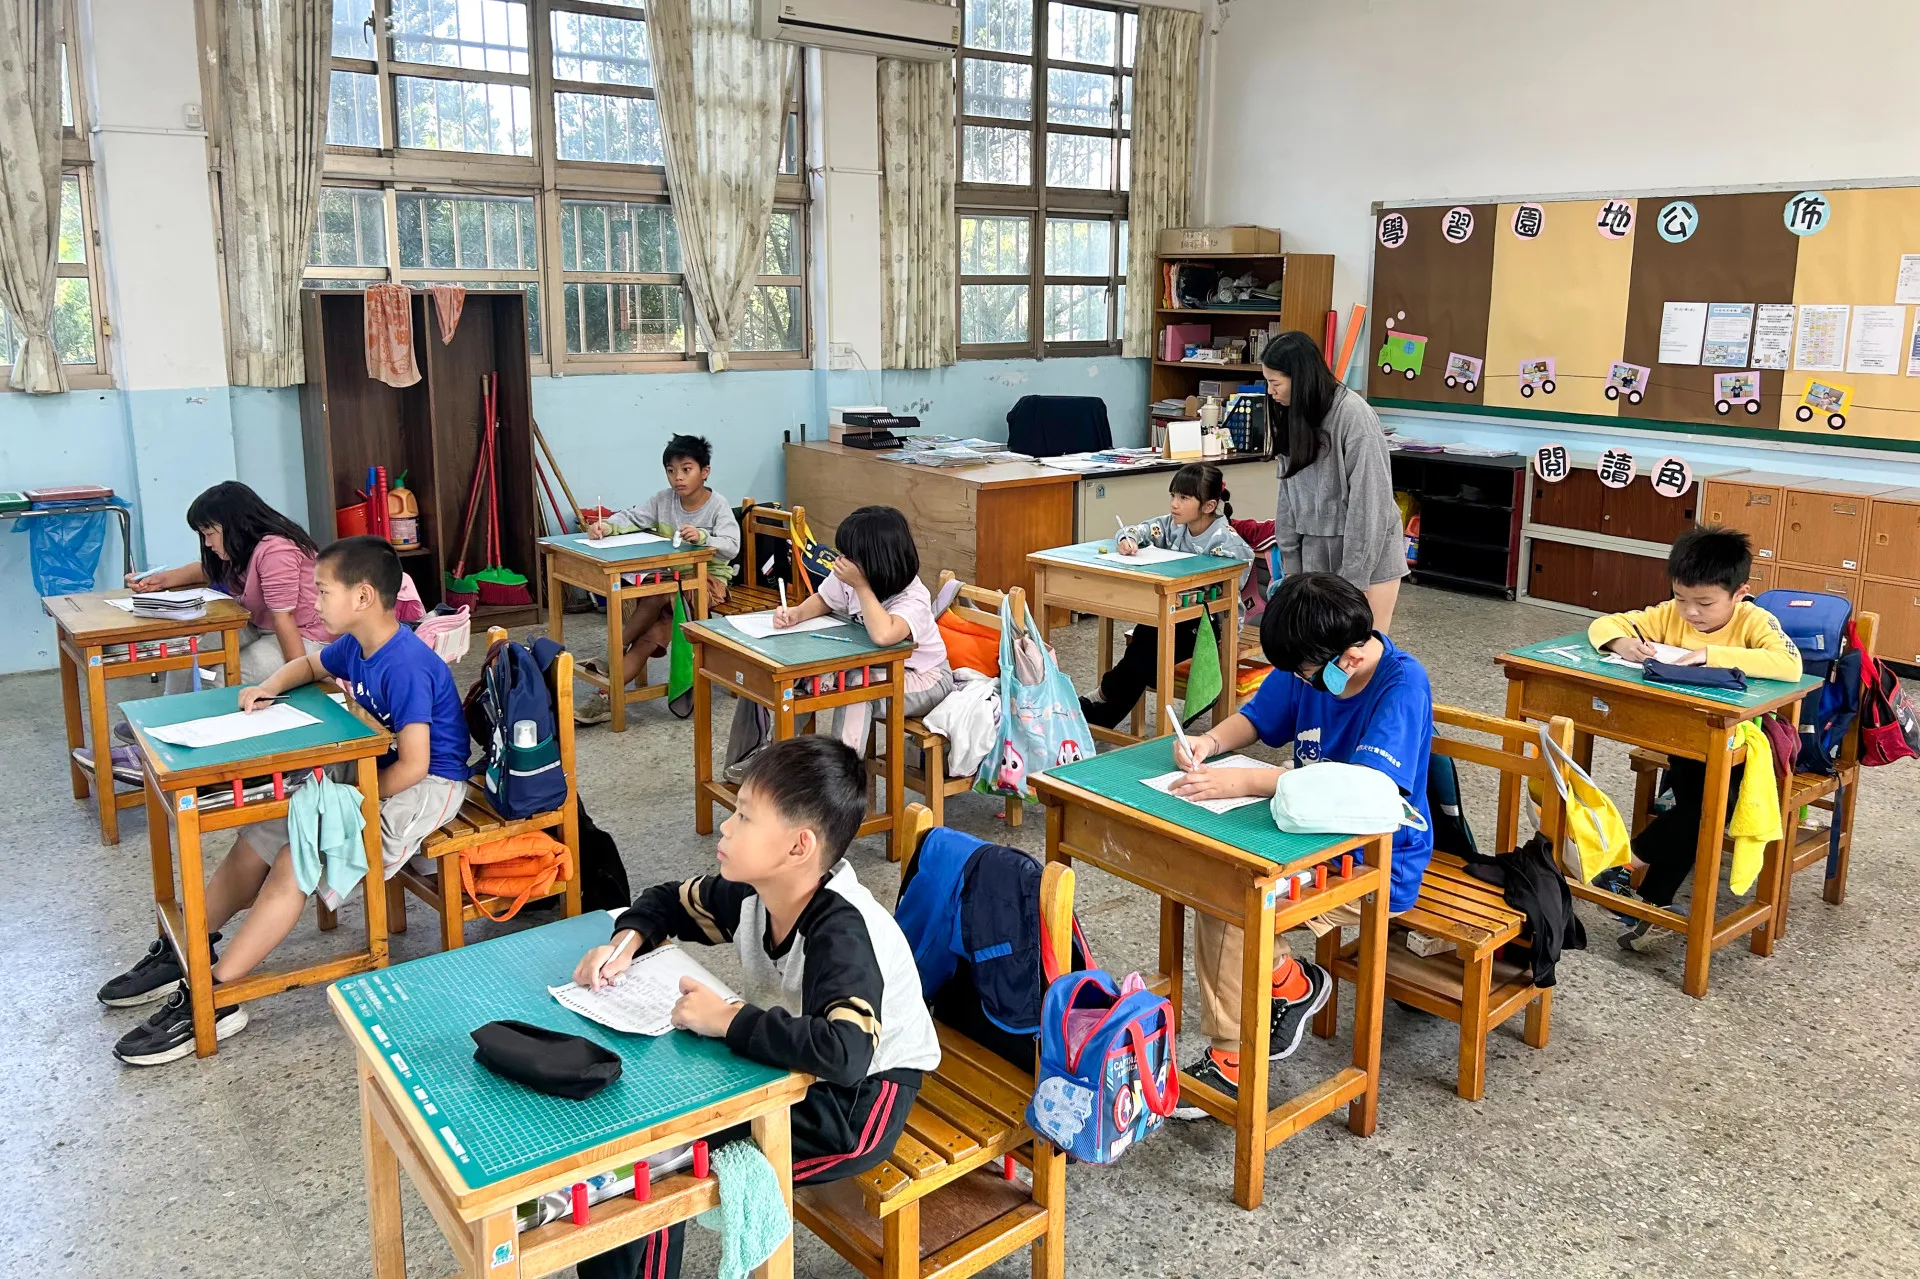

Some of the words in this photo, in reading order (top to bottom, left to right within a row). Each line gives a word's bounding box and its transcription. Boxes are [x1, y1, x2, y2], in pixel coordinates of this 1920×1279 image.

[1382, 201, 1631, 244] 學習園地
[1663, 197, 1825, 238] 公佈
[1539, 447, 1686, 493] 閱讀角
